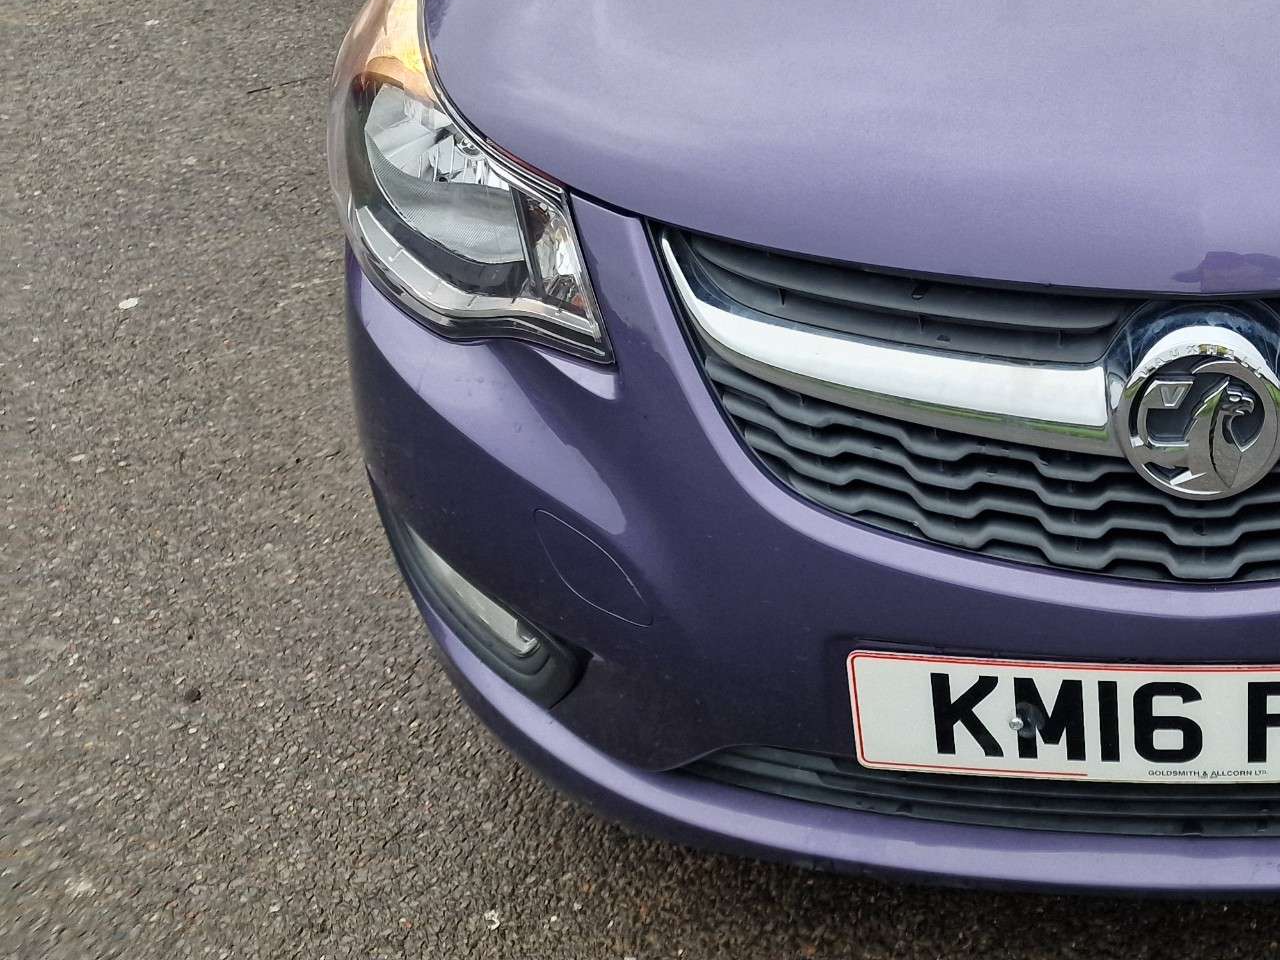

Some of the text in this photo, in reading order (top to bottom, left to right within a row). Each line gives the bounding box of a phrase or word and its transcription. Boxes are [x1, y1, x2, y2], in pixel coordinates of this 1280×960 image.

[930, 672, 1204, 763] KM16
[1148, 769, 1200, 777] GOLDSMITH
[1210, 770, 1252, 778] ALLCORN
